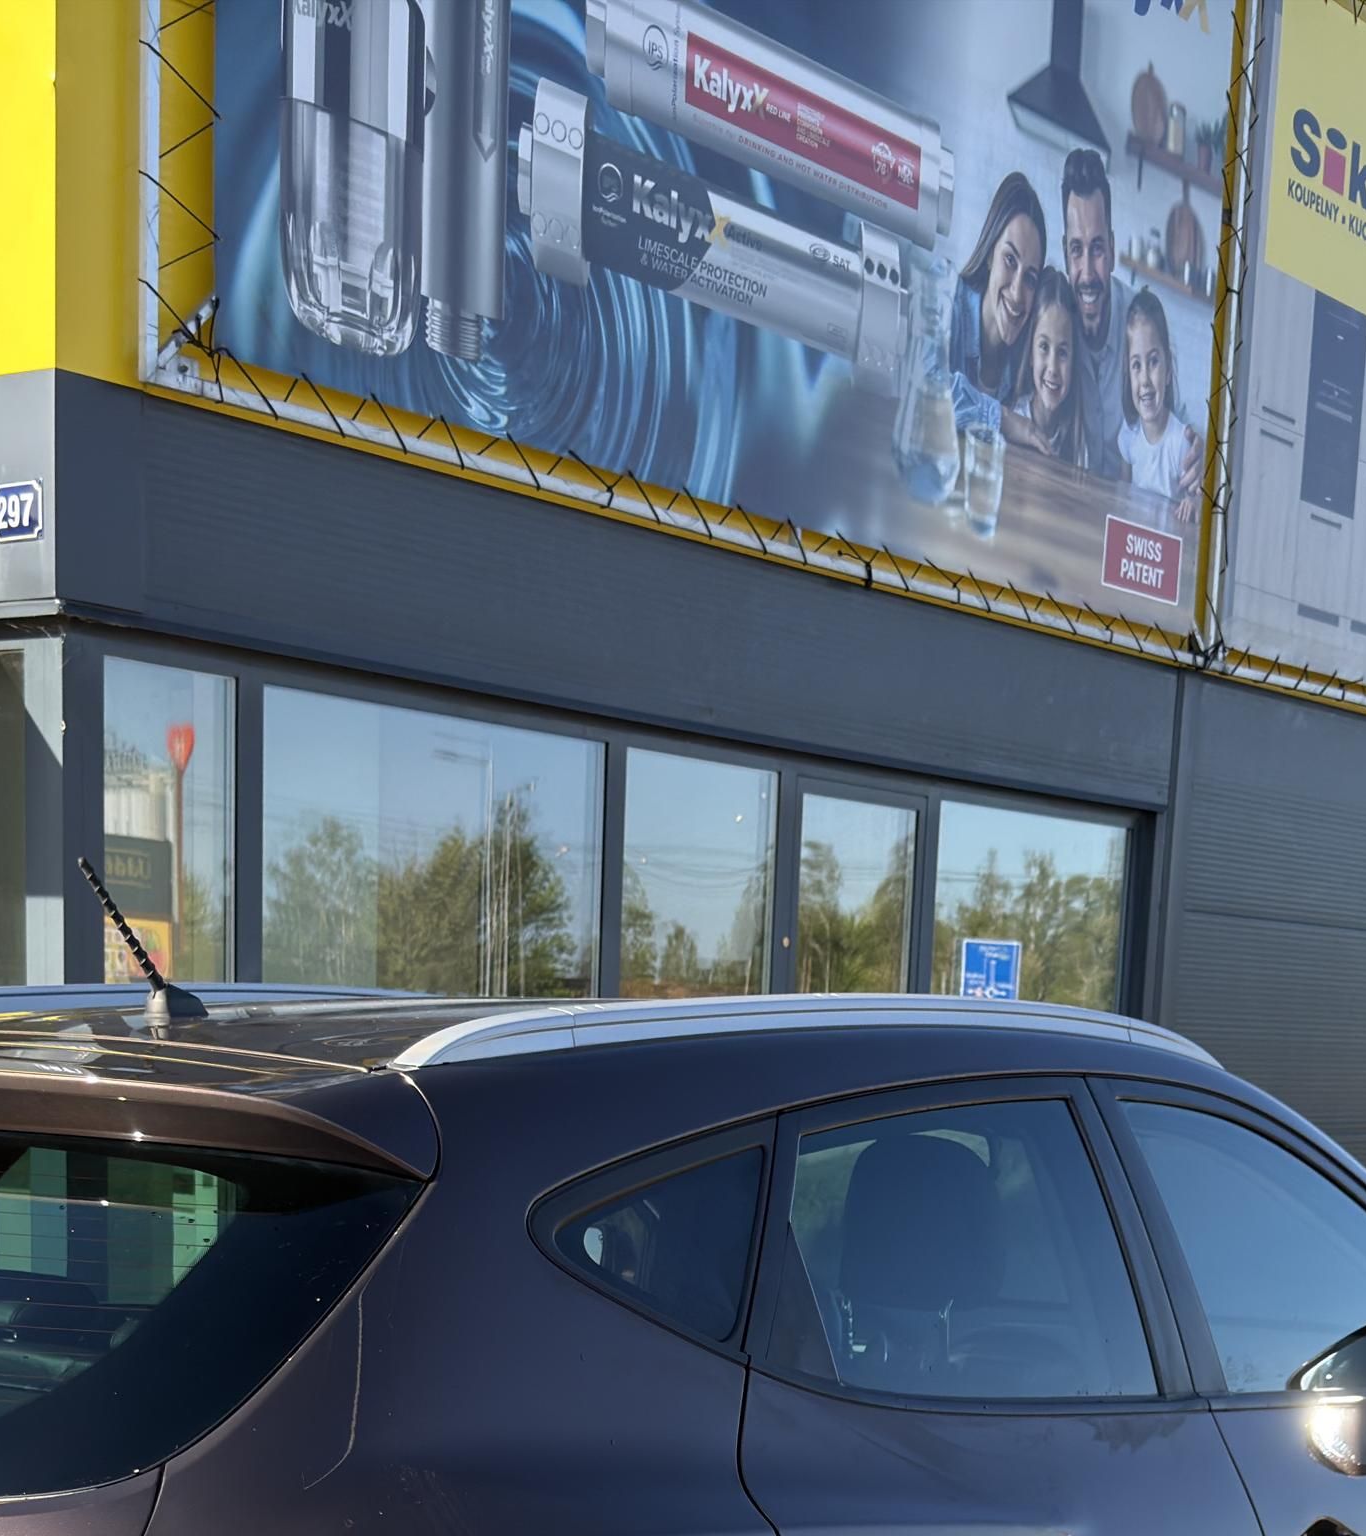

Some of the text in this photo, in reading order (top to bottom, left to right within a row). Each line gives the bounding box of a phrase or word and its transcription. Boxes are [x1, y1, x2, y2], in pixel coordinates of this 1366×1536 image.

[765, 103, 778, 116] RED
[778, 110, 792, 123] LINE
[738, 135, 776, 158] DRINKING
[778, 154, 794, 167] AND
[795, 162, 811, 176] HOT
[813, 166, 837, 186] WATER
[1287, 178, 1340, 223] KOUPELNY
[638, 235, 698, 270] LIMESCALE
[699, 260, 768, 299] PROTECTION
[640, 254, 754, 306] & WATER ACTIVATION
[832, 255, 851, 272] SAT
[1125, 533, 1162, 562] SWISS
[1120, 558, 1165, 589] PATENT
